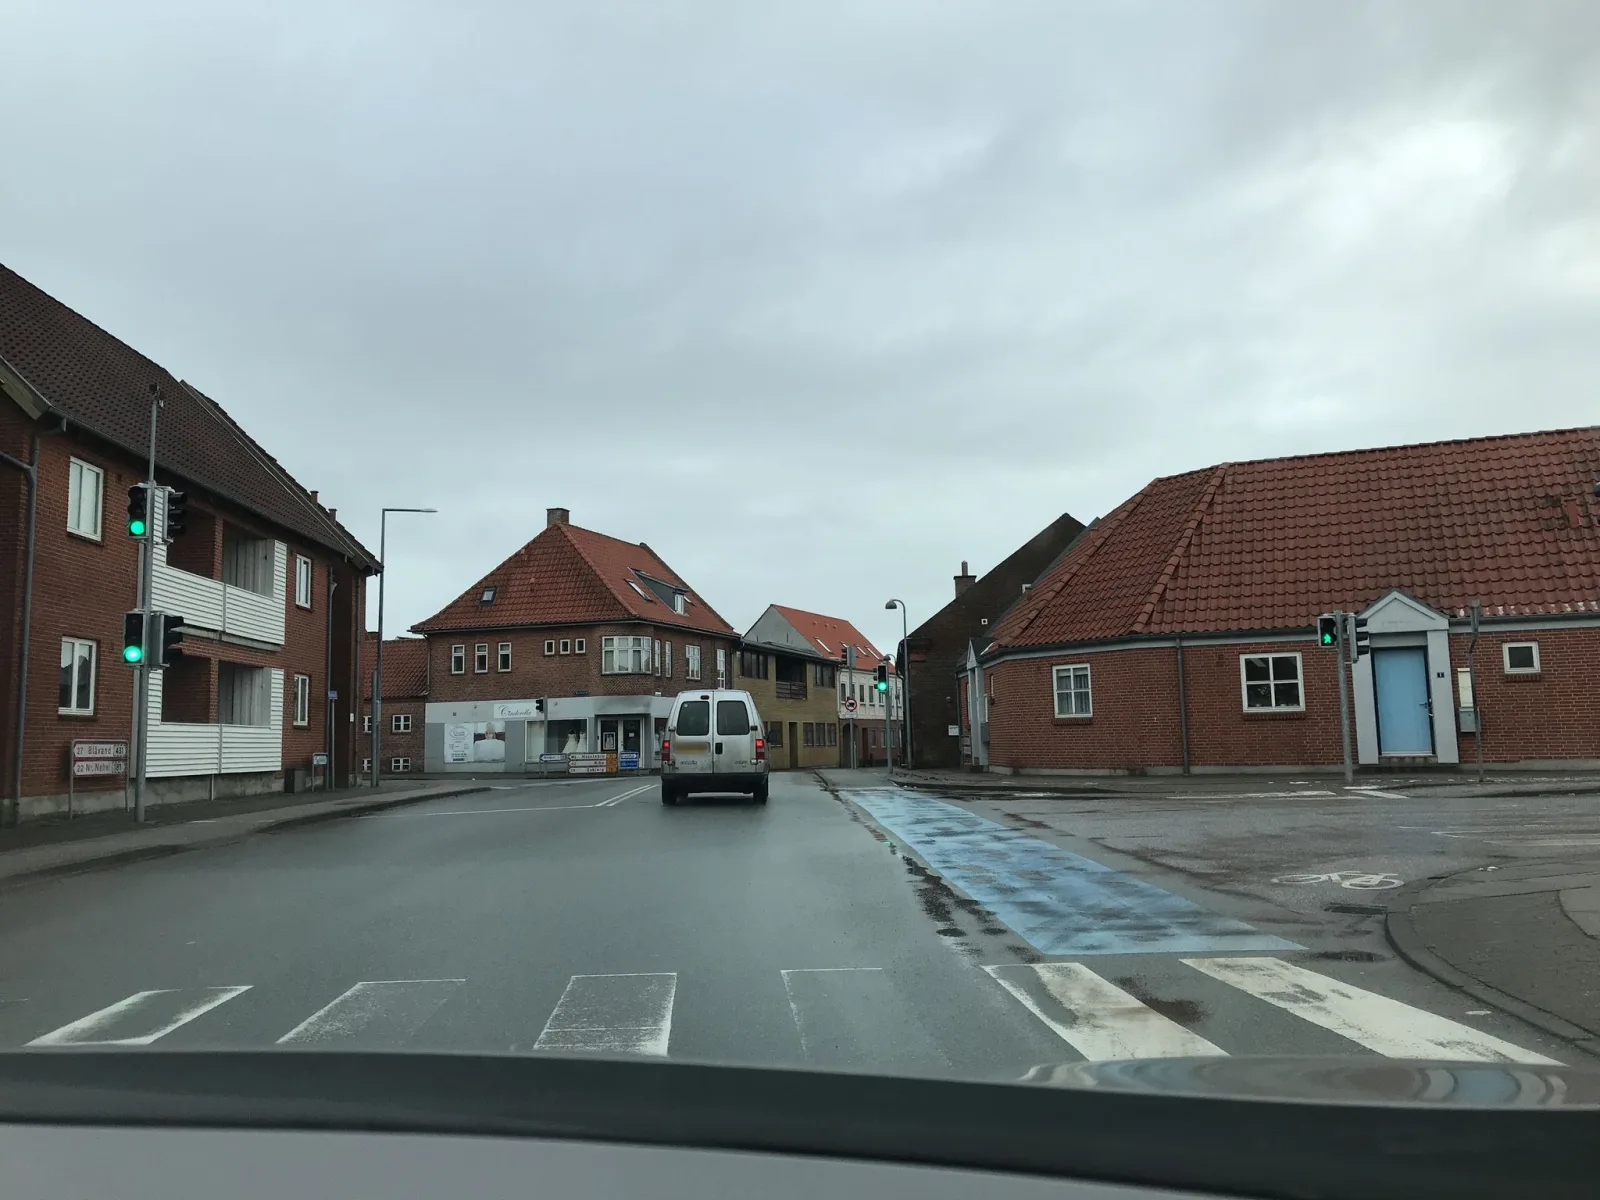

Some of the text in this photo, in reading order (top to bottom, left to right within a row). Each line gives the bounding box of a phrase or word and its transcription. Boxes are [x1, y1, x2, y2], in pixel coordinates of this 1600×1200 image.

[77, 747, 84, 755] 27
[88, 746, 112, 755] Blåvand
[77, 764, 84, 772] 22
